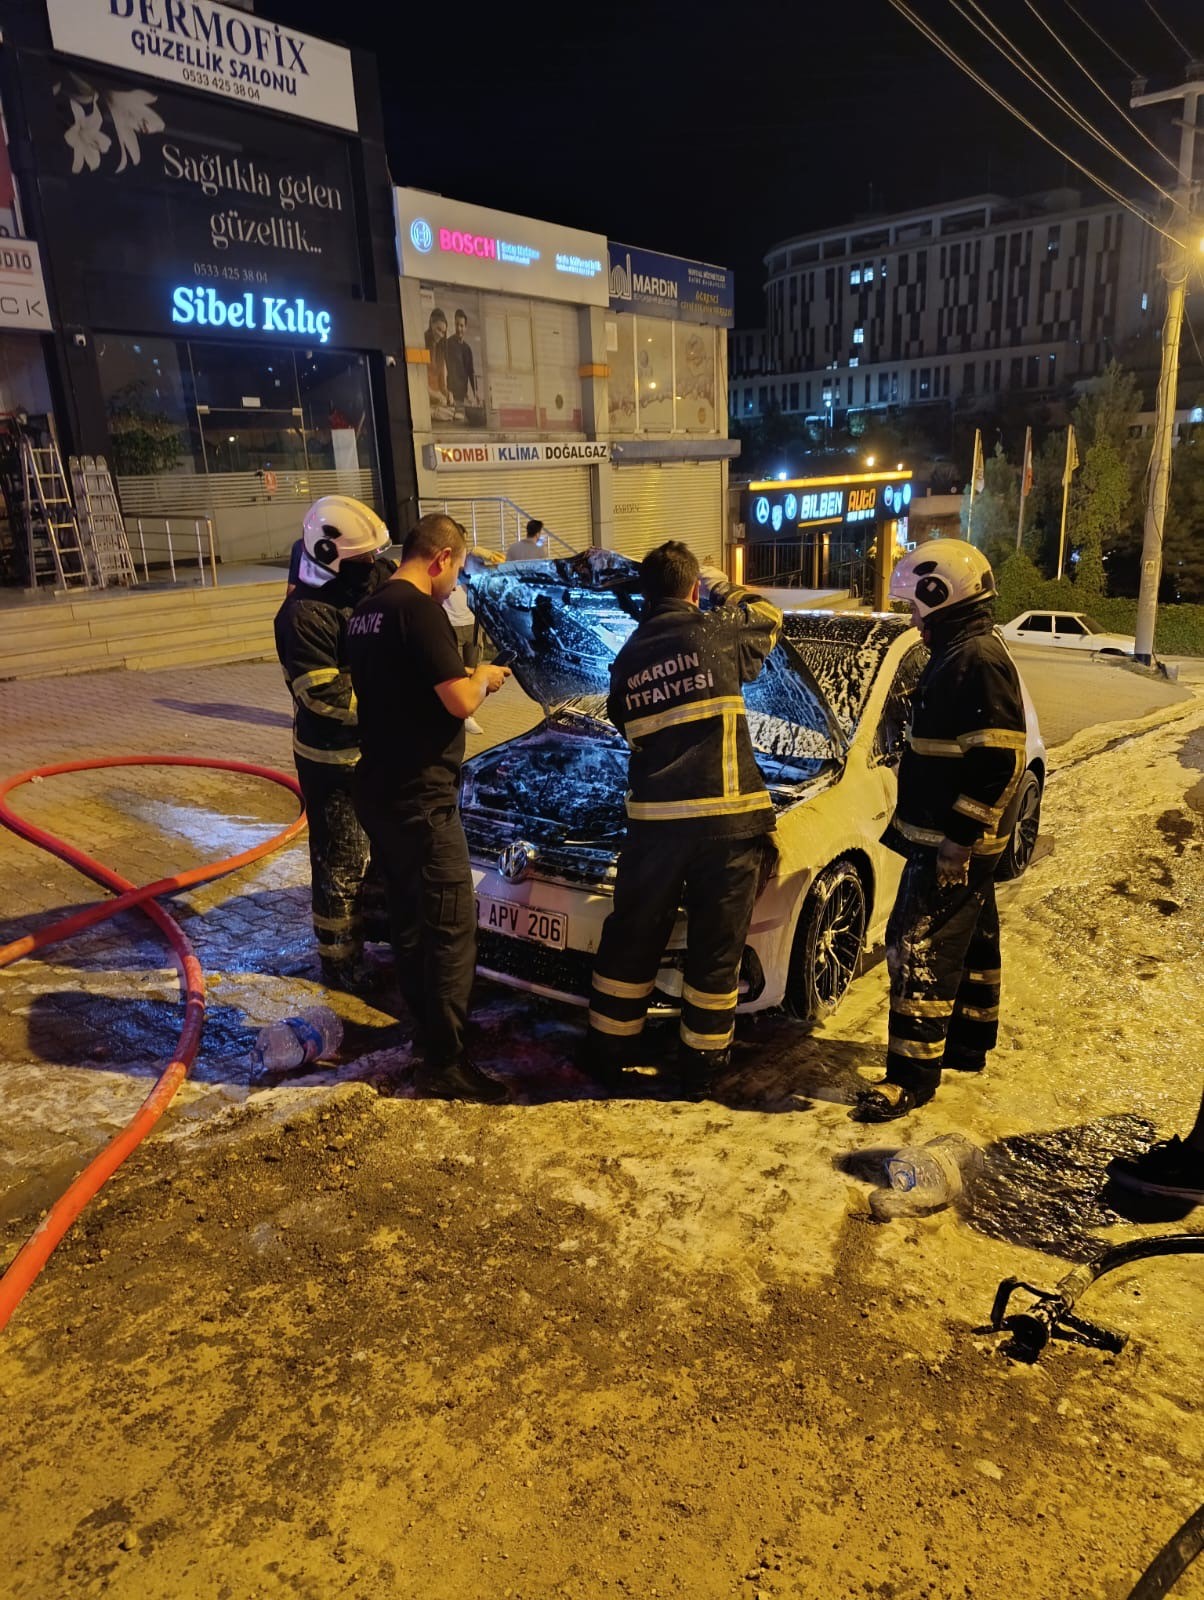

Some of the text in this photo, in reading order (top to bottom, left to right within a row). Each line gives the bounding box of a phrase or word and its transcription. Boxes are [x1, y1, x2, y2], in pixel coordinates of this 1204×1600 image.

[131, 28, 297, 96] GÜZELLİK SALONU
[182, 67, 261, 100] 0533 425 38 04
[162, 143, 342, 212] Sağlıkla gelen
[438, 228, 496, 260] BOSCH
[193, 261, 269, 284] 0533 425 38 04
[172, 286, 332, 344] Sibel Kılıç
[441, 443, 607, 463] KOMBİ KLİMA DOĞALGAZ
[625, 668, 714, 711] İTFAİYESİ
[627, 652, 699, 690] MARDİN
[489, 903, 519, 931] APV
[527, 913, 561, 942] 206
